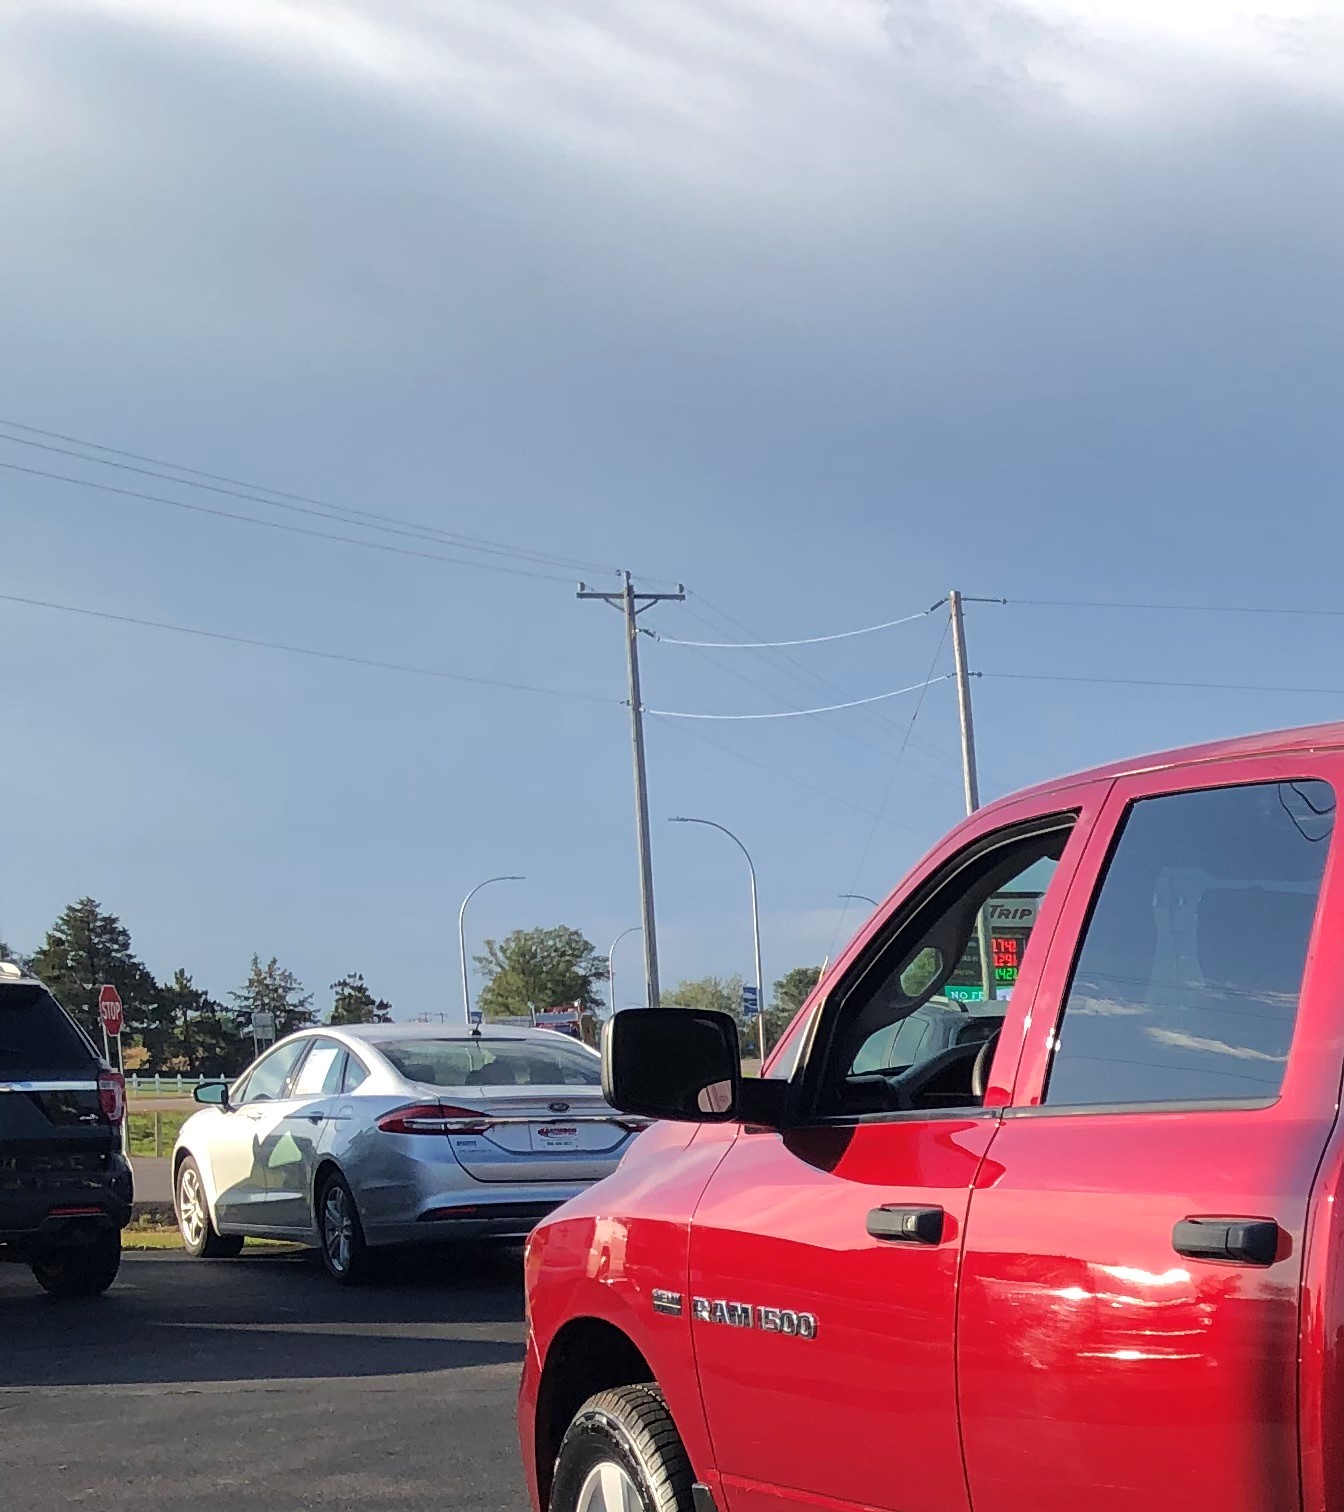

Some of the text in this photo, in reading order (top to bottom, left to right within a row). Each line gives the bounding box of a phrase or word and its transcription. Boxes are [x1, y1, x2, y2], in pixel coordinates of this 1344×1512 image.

[989, 903, 1032, 920] TRIP
[102, 1001, 120, 1020] STOP
[692, 1295, 817, 1340] RAM 1500
